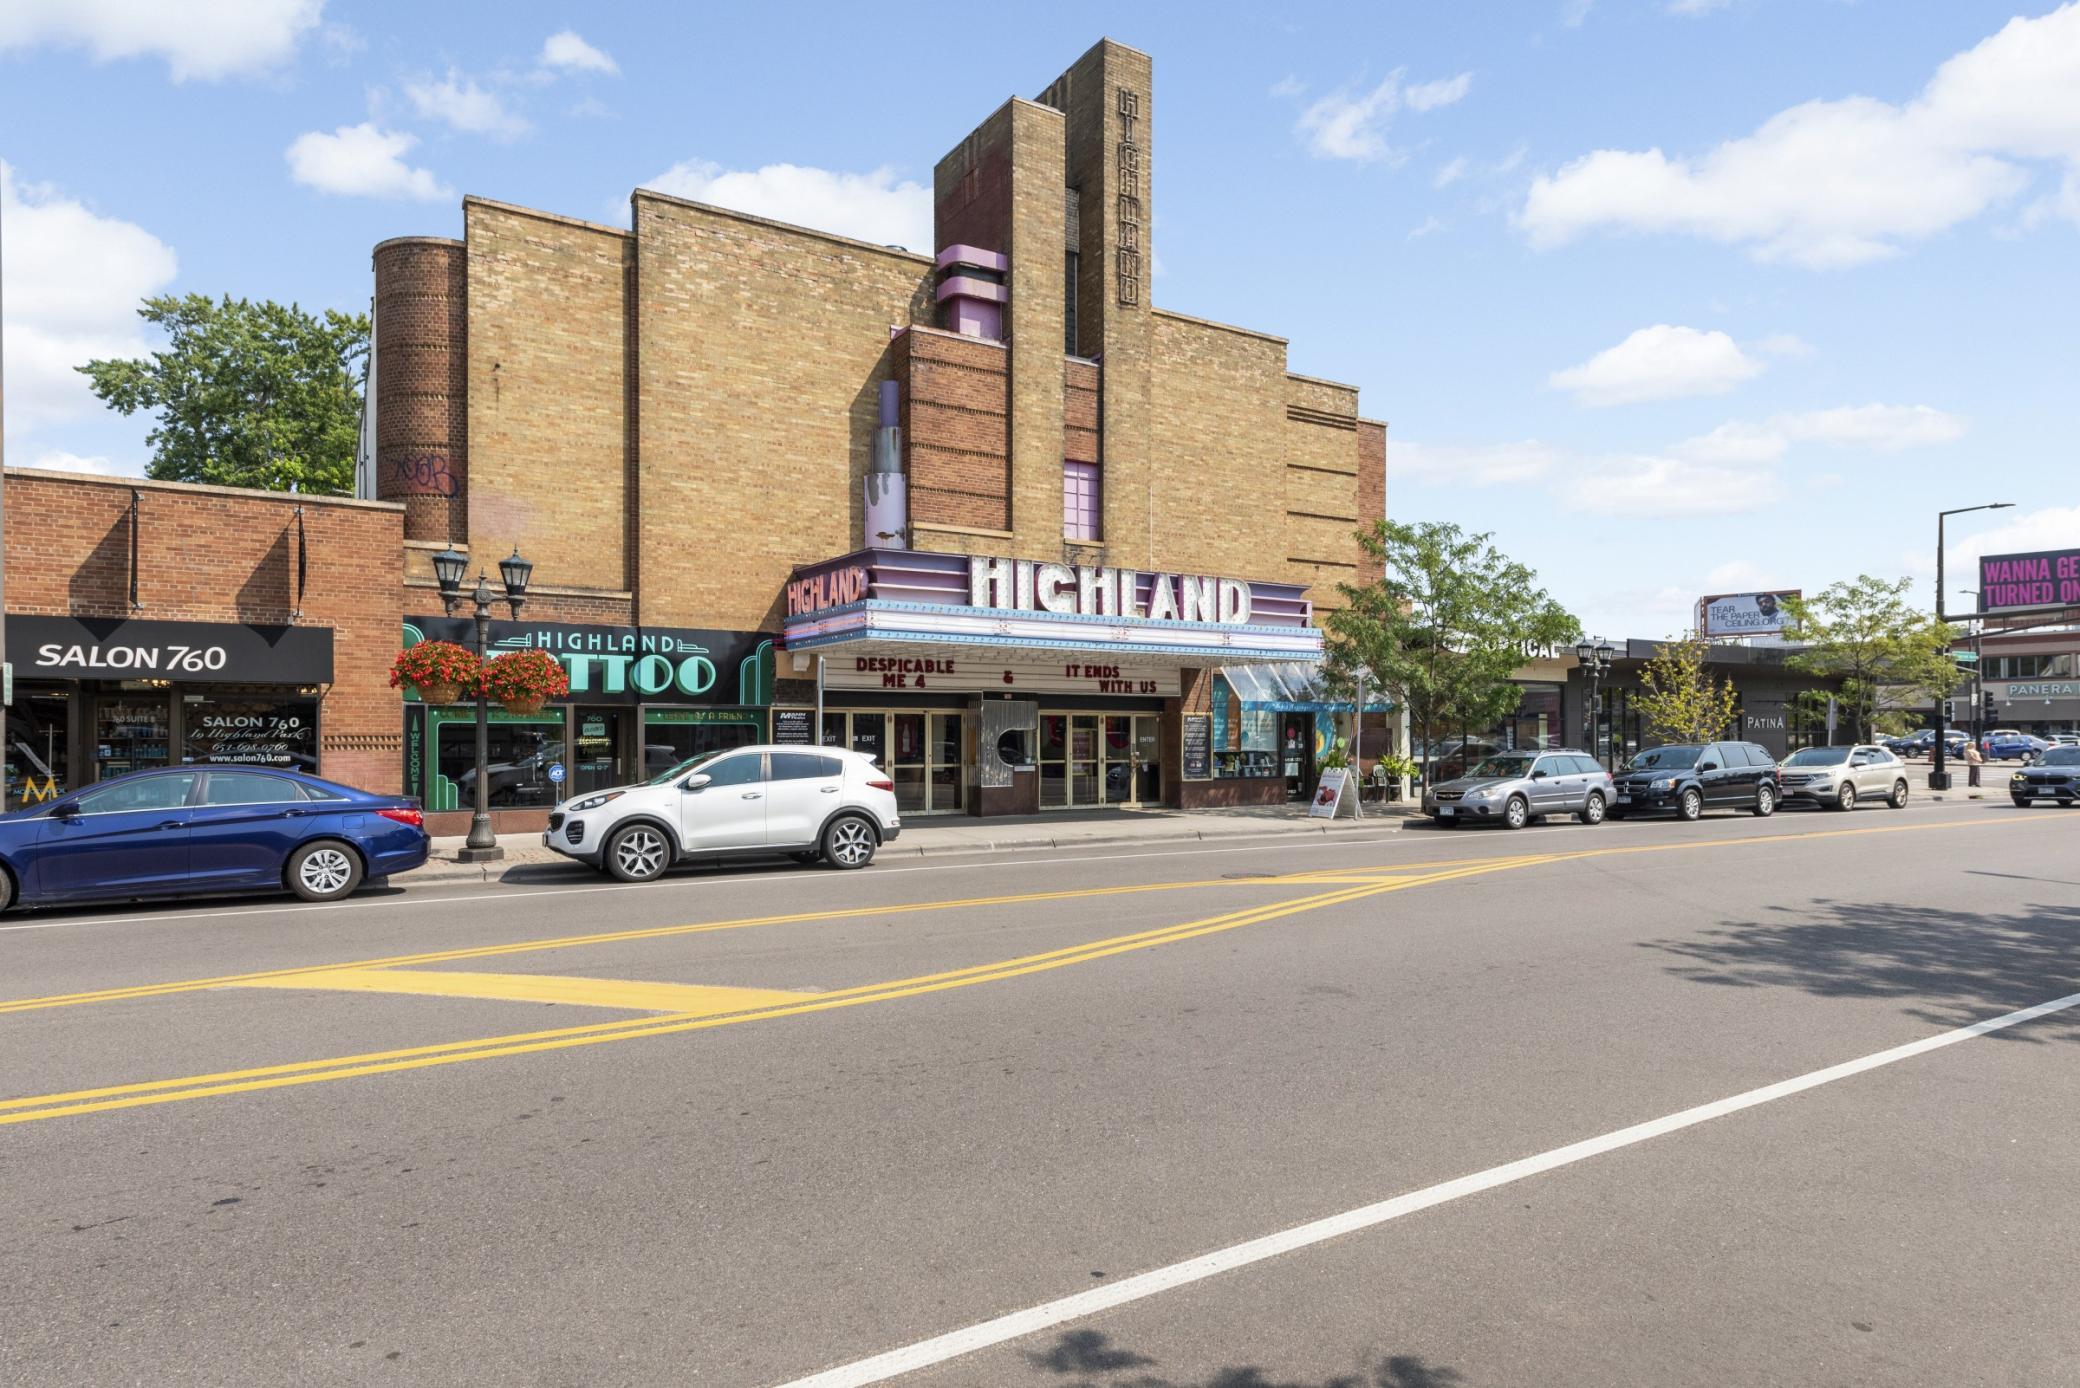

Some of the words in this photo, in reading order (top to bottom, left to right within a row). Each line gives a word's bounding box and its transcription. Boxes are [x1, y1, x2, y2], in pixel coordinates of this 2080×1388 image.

[1117, 87, 1142, 305] HIGHLAND
[1983, 558, 2051, 583] WANNA
[787, 566, 861, 617] HIGHLAND
[971, 554, 1251, 625] HIGHLAND
[1983, 582, 2055, 607] TURNED
[1711, 605, 1735, 614] TEAR
[1711, 613, 1728, 621] THE
[1731, 611, 1760, 620] PAPER
[1725, 617, 1784, 628] CEILING.ORG
[537, 631, 674, 652] HIGHLAND
[35, 644, 159, 669] SALON
[165, 645, 226, 672] 760
[486, 650, 717, 695] TTOO
[856, 657, 955, 674] DESPICABLE
[1003, 670, 1014, 684] &
[1065, 664, 1081, 678] IT
[1084, 664, 1120, 678] ENDS
[882, 673, 907, 688] ME
[914, 673, 927, 688] 4
[1098, 680, 1133, 694] WITH
[1139, 681, 1157, 694] US
[2009, 684, 2072, 695] PANERA
[126, 715, 148, 723] SUITE
[203, 716, 262, 727] SALON
[268, 717, 300, 730] 760
[1747, 716, 1784, 729] PATINA
[190, 729, 205, 739] In
[207, 729, 271, 740] Highland
[272, 727, 311, 739] Park
[823, 735, 836, 743] EXIT
[861, 735, 876, 743] EXIT
[209, 753, 291, 763] www.salon760.com
[410, 732, 420, 782] WELCOME
